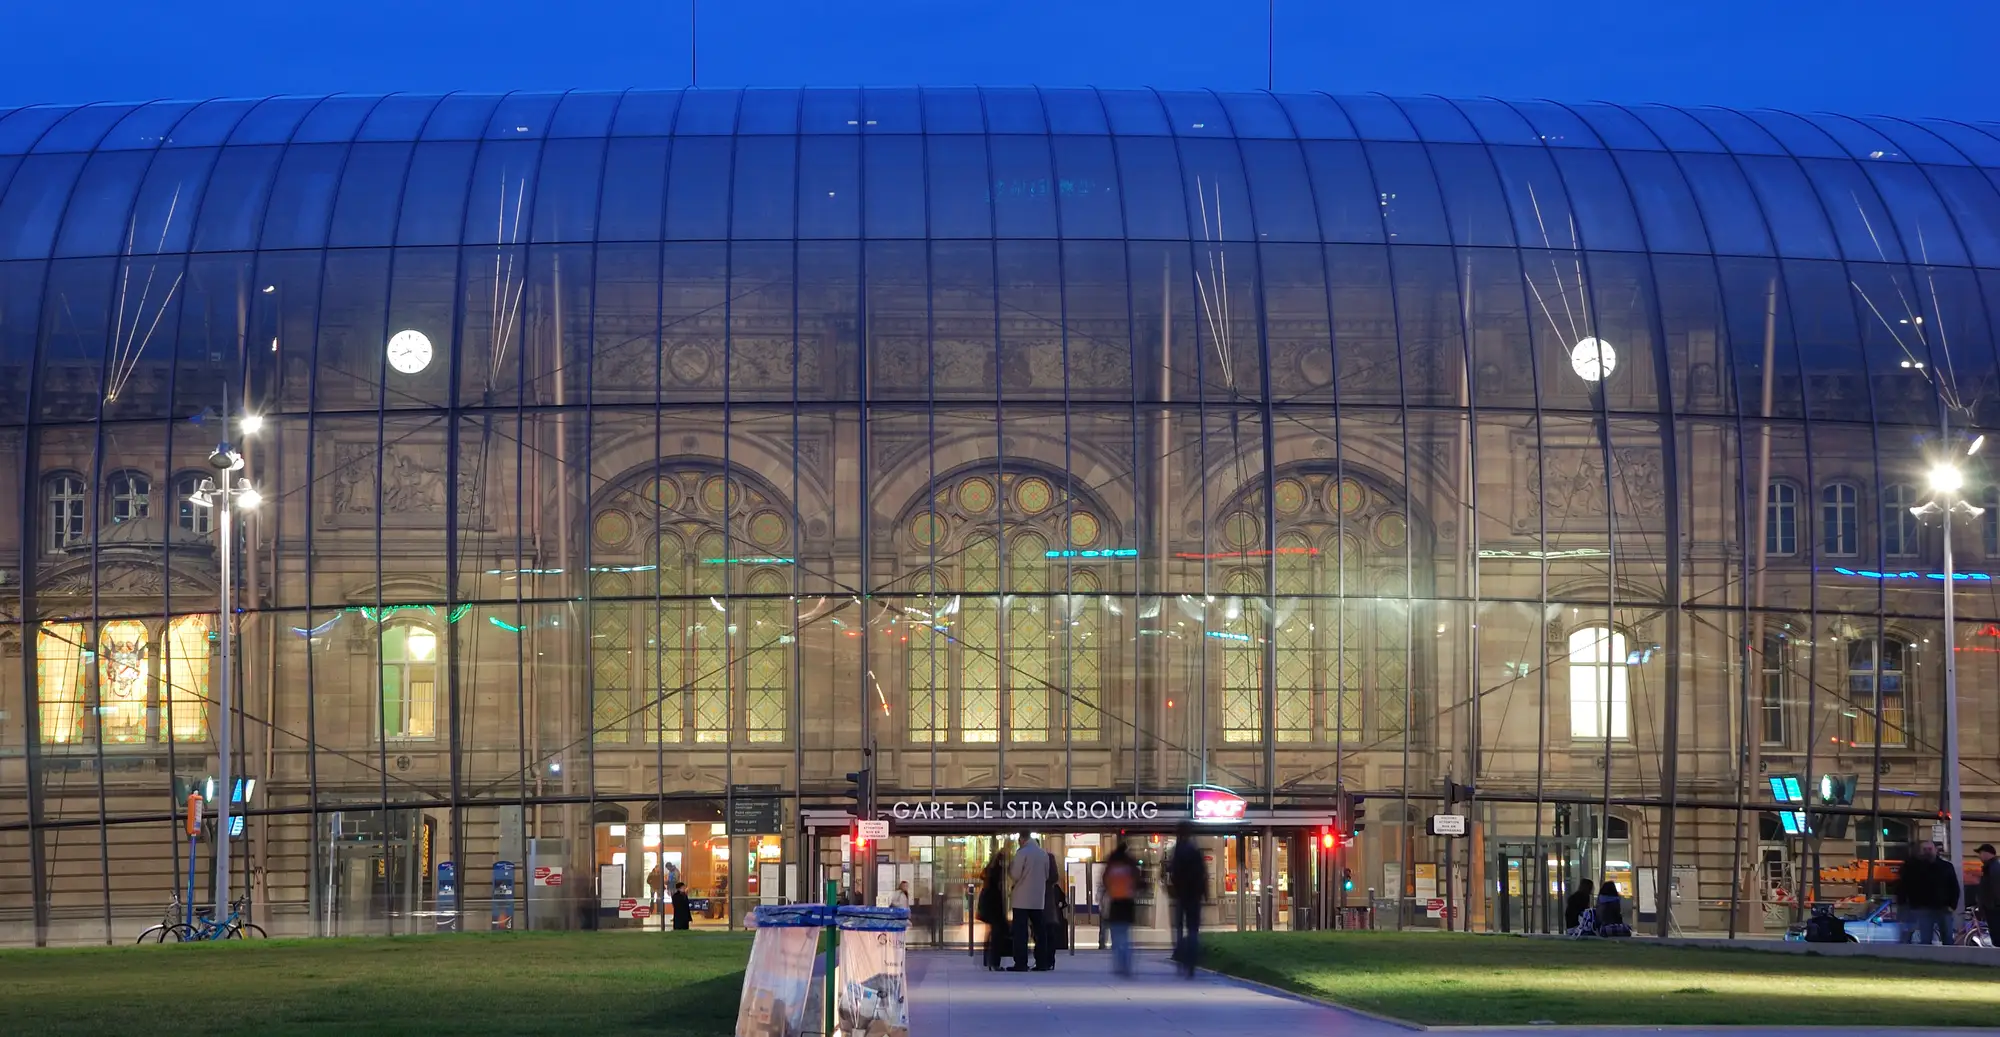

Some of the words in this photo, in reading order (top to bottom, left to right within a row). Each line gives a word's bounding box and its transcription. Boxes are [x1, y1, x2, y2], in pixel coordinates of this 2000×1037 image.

[893, 801, 955, 820] GARE
[966, 801, 993, 820] DE
[1005, 800, 1158, 820] STRASBOURG
